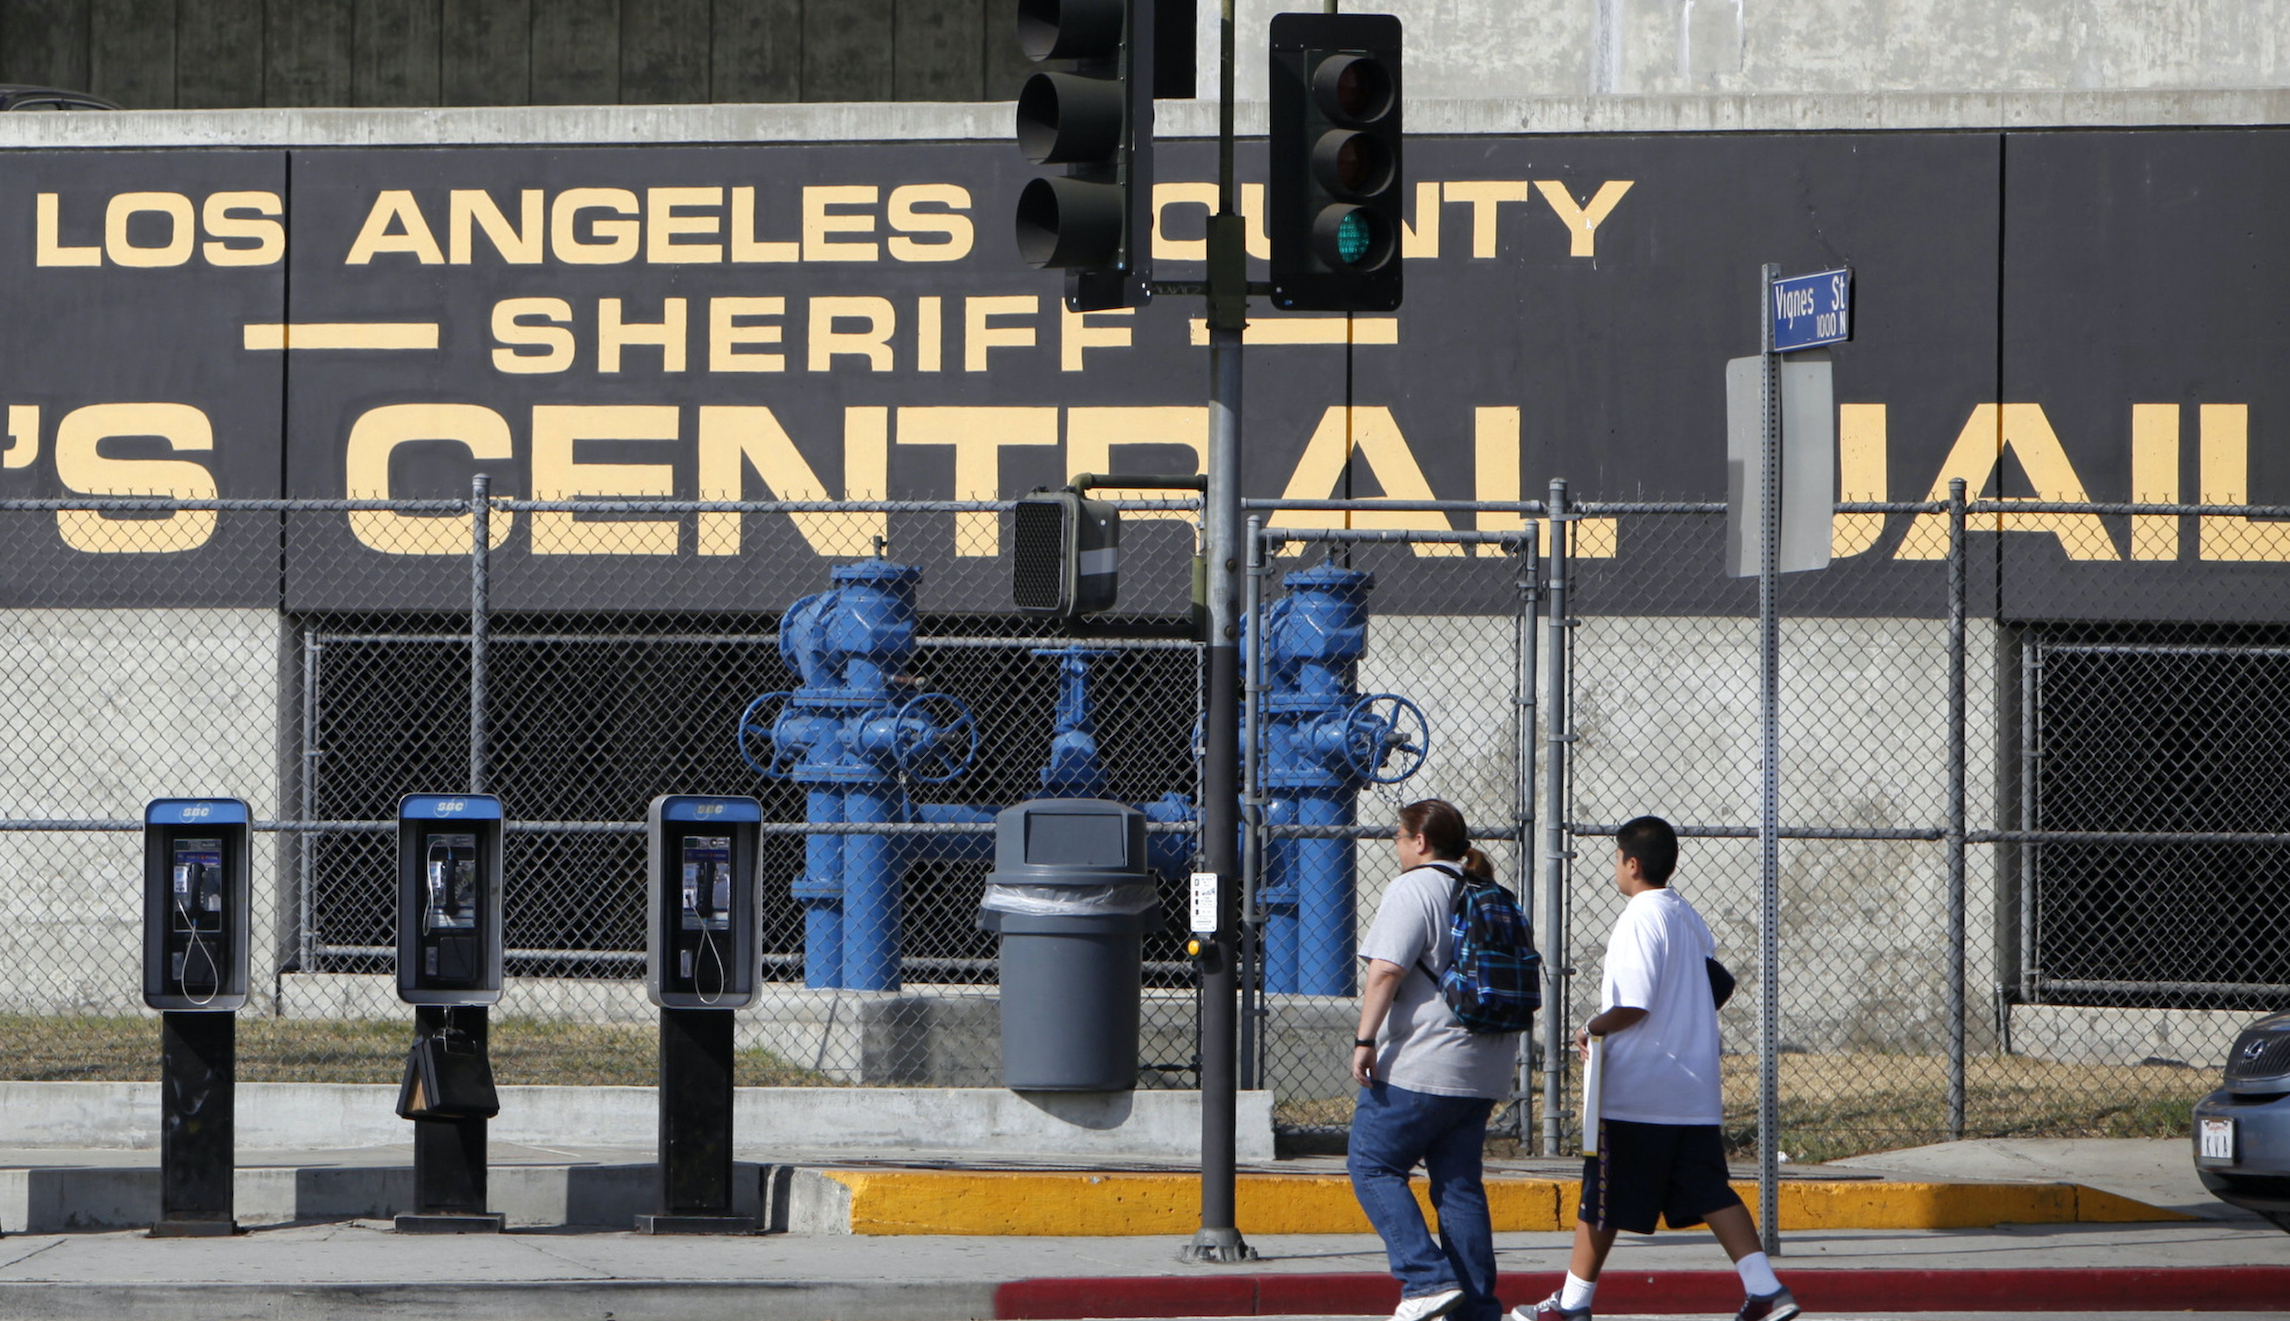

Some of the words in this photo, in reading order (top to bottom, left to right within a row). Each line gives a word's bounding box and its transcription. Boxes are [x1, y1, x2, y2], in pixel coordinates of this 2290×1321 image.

[37, 191, 286, 266] LOS
[345, 184, 974, 264] ANGELES
[1775, 285, 1815, 330] Vignes
[1831, 275, 1846, 311] St
[1816, 312, 1837, 338] 1000
[1839, 311, 1846, 335] N
[491, 296, 1135, 373] SHERIFF
[346, 404, 1616, 558] CENTRAL
[182, 807, 209, 817] SBC
[437, 802, 464, 811] SBC
